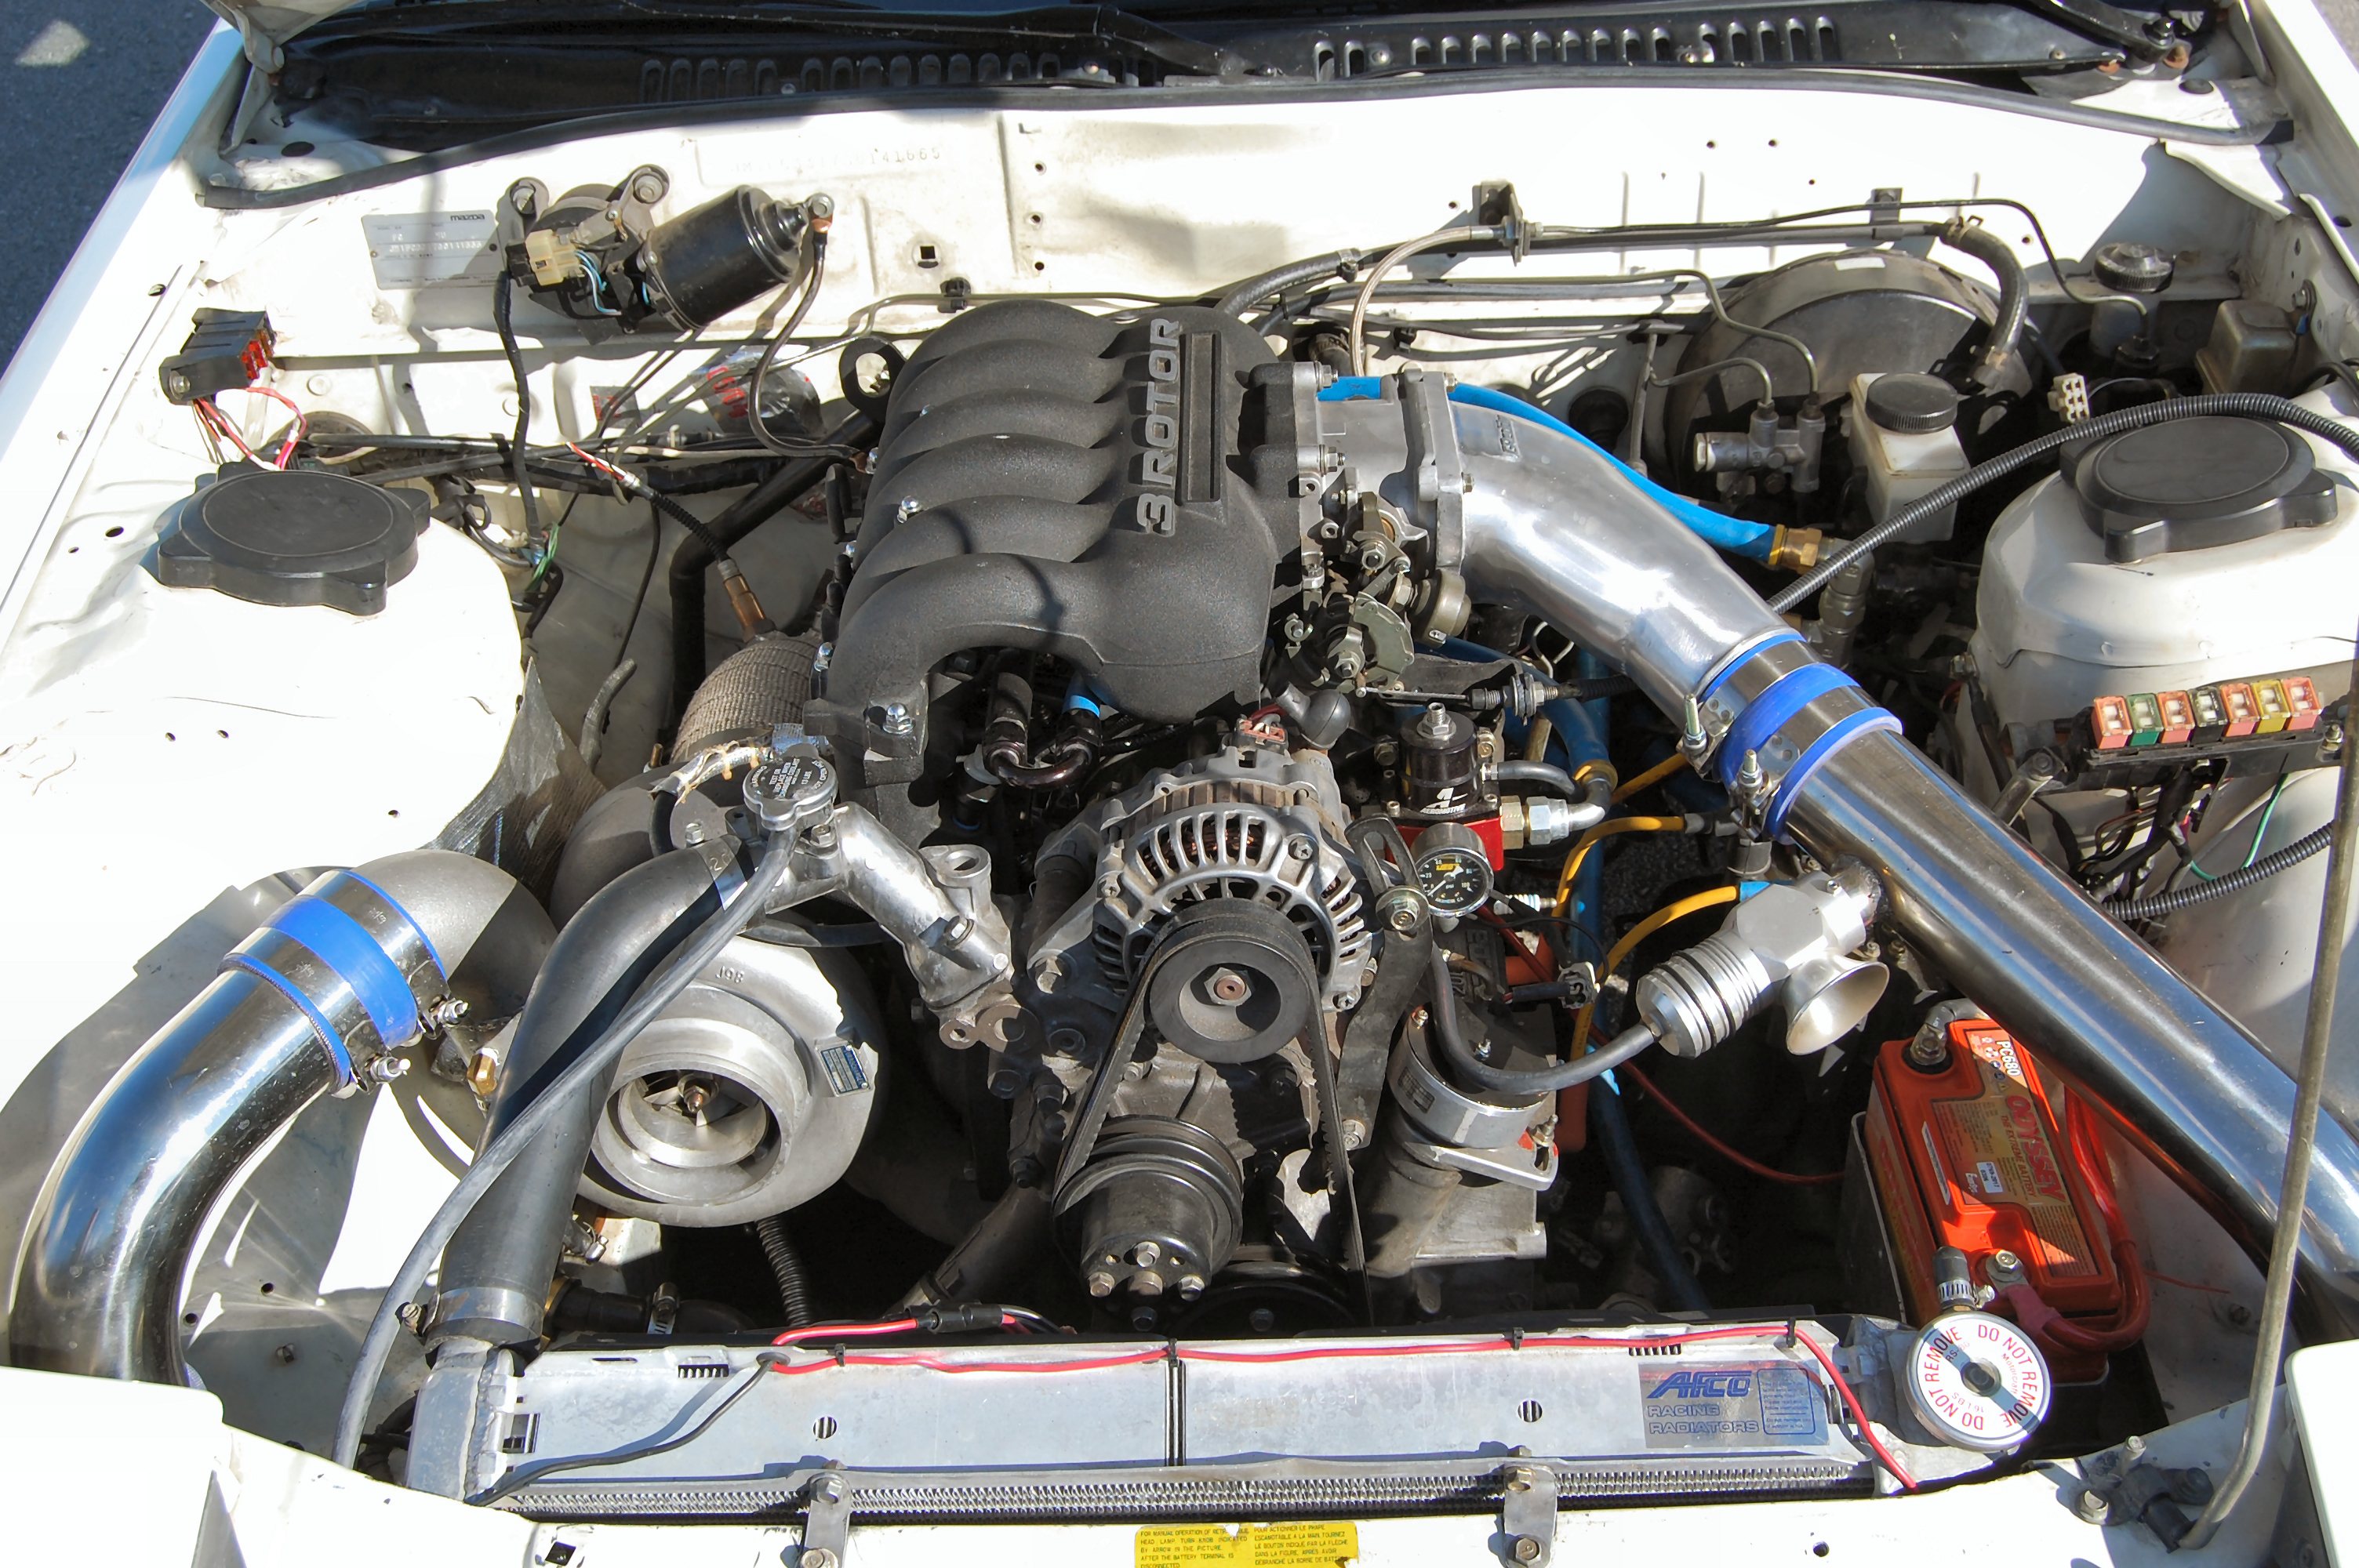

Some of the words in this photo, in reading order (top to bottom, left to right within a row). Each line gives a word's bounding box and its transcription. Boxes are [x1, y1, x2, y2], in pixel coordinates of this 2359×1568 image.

[1142, 318, 1179, 485] ROTOR
[1996, 1040, 2022, 1077] PC680
[2001, 1115, 2011, 1131] THE
[2005, 1130, 2023, 1163] EXTREME
[2005, 1095, 2067, 1203] ODYSSEY
[2016, 1162, 2038, 1199] BATTERY
[1978, 1324, 2000, 1342] DO
[1924, 1327, 1962, 1382] REMOVE
[2002, 1337, 2033, 1365] NOT
[1646, 1370, 1753, 1399] AFCO
[2001, 1353, 2019, 1395] Motorcraft
[1648, 1404, 1721, 1417] RACING
[1928, 1388, 1959, 1417] NOT
[2000, 1371, 2038, 1428] REMOVE
[1649, 1421, 1760, 1435] RADIATORS
[1961, 1412, 1984, 1431] DO
